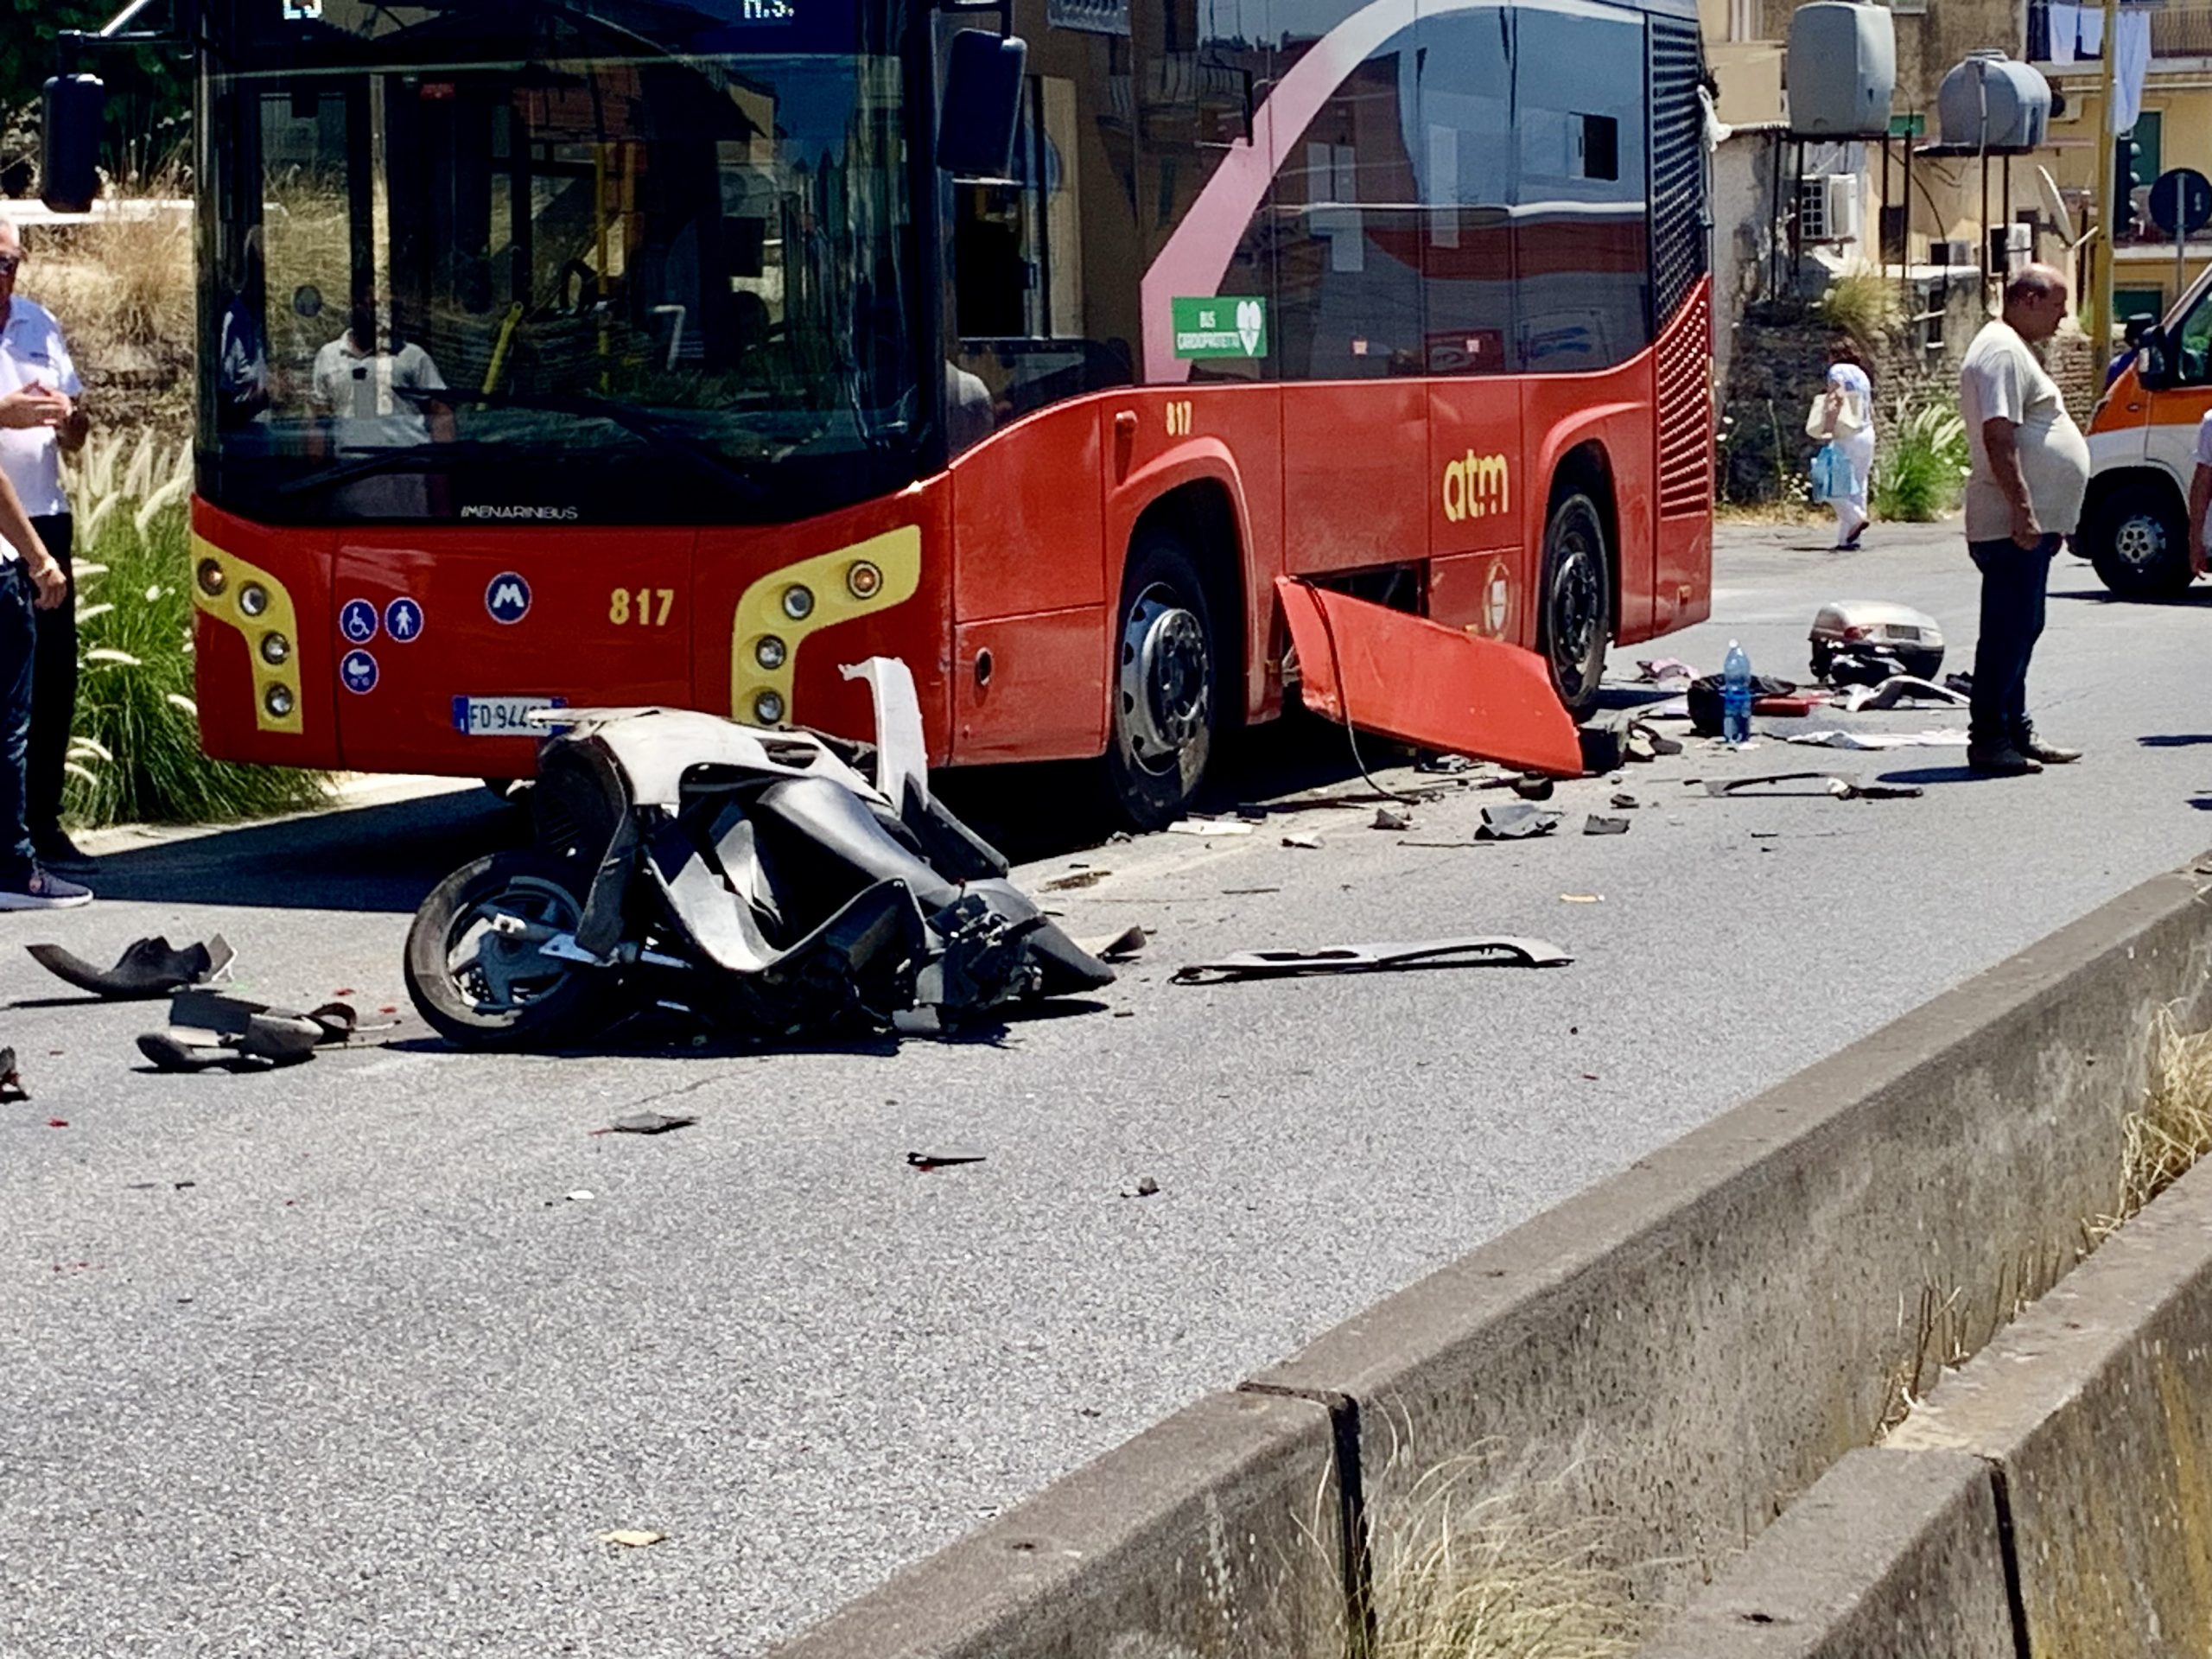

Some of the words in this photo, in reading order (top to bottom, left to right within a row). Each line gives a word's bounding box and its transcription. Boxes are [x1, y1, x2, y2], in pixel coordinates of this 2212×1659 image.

[1166, 400, 1192, 436] 817
[1443, 448, 1509, 522] atm
[609, 588, 674, 626] 817
